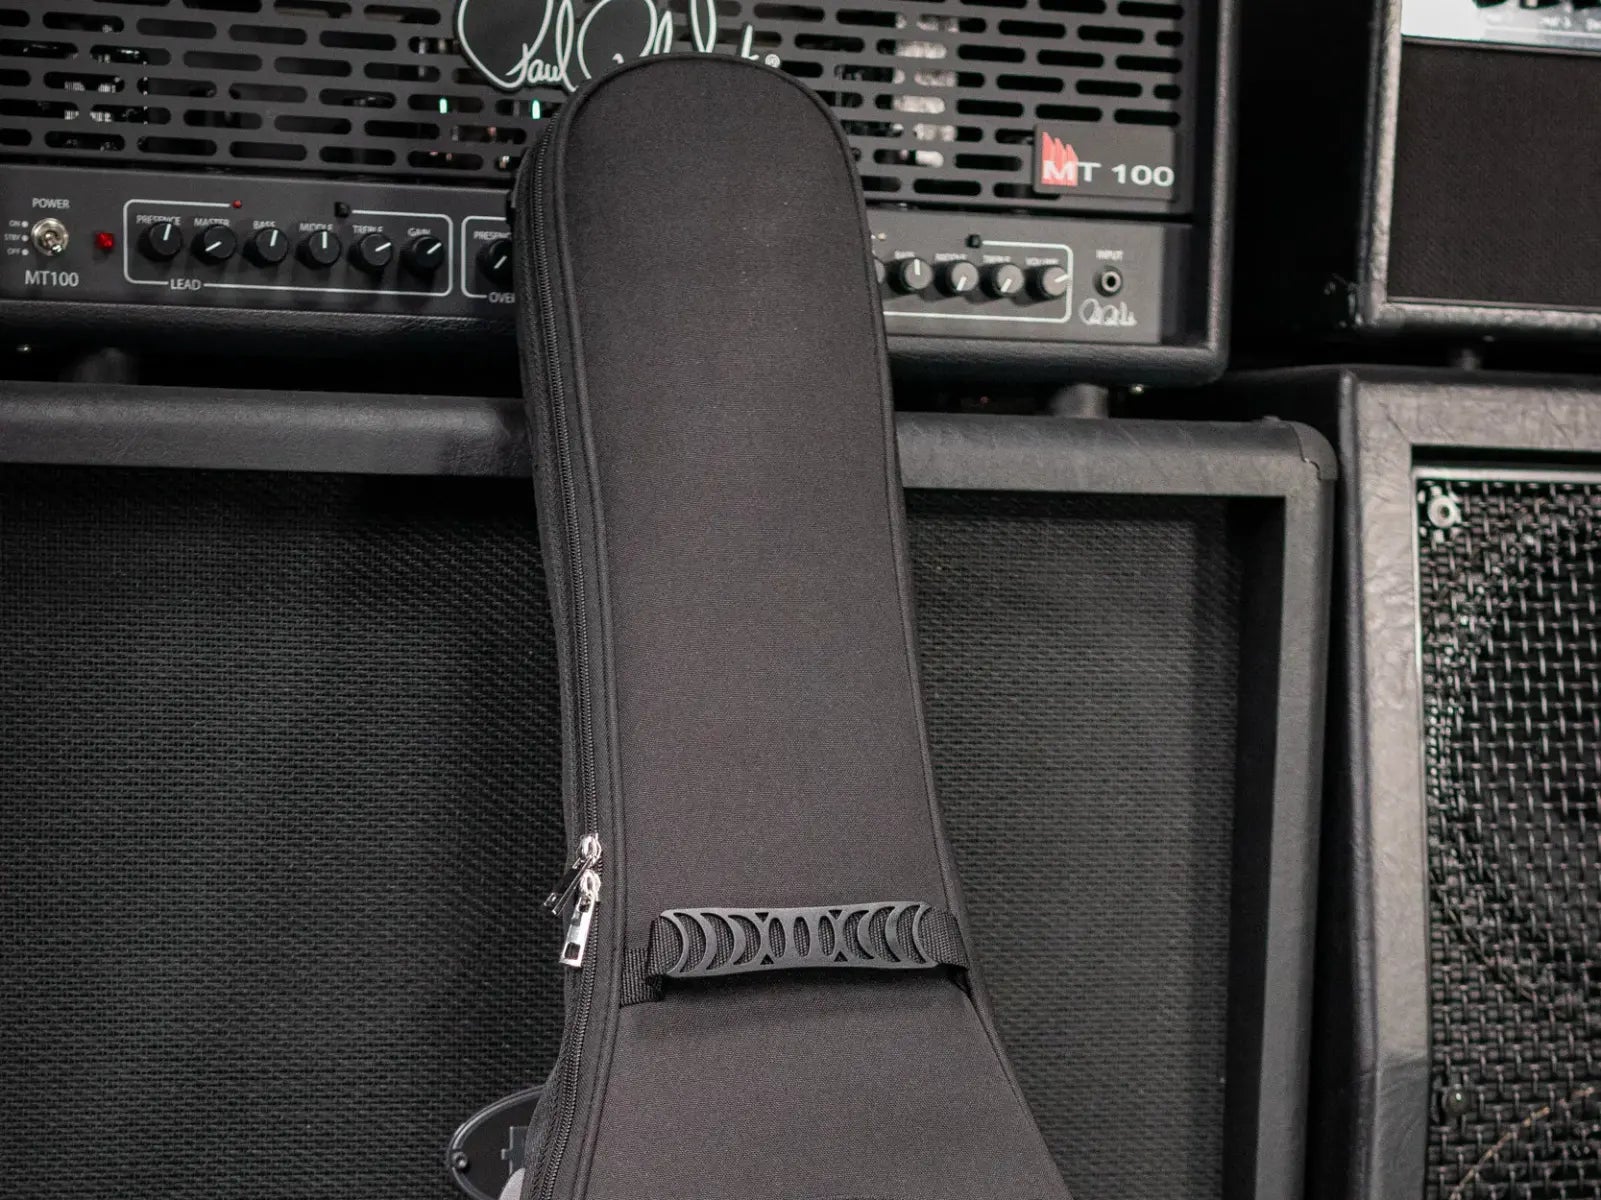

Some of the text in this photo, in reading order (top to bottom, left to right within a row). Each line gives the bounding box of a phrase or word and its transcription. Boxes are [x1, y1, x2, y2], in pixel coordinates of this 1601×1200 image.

[1042, 160, 1175, 187] MT 100
[32, 197, 70, 209] POWER
[24, 269, 80, 287] MT100
[170, 278, 201, 291] LEAD
